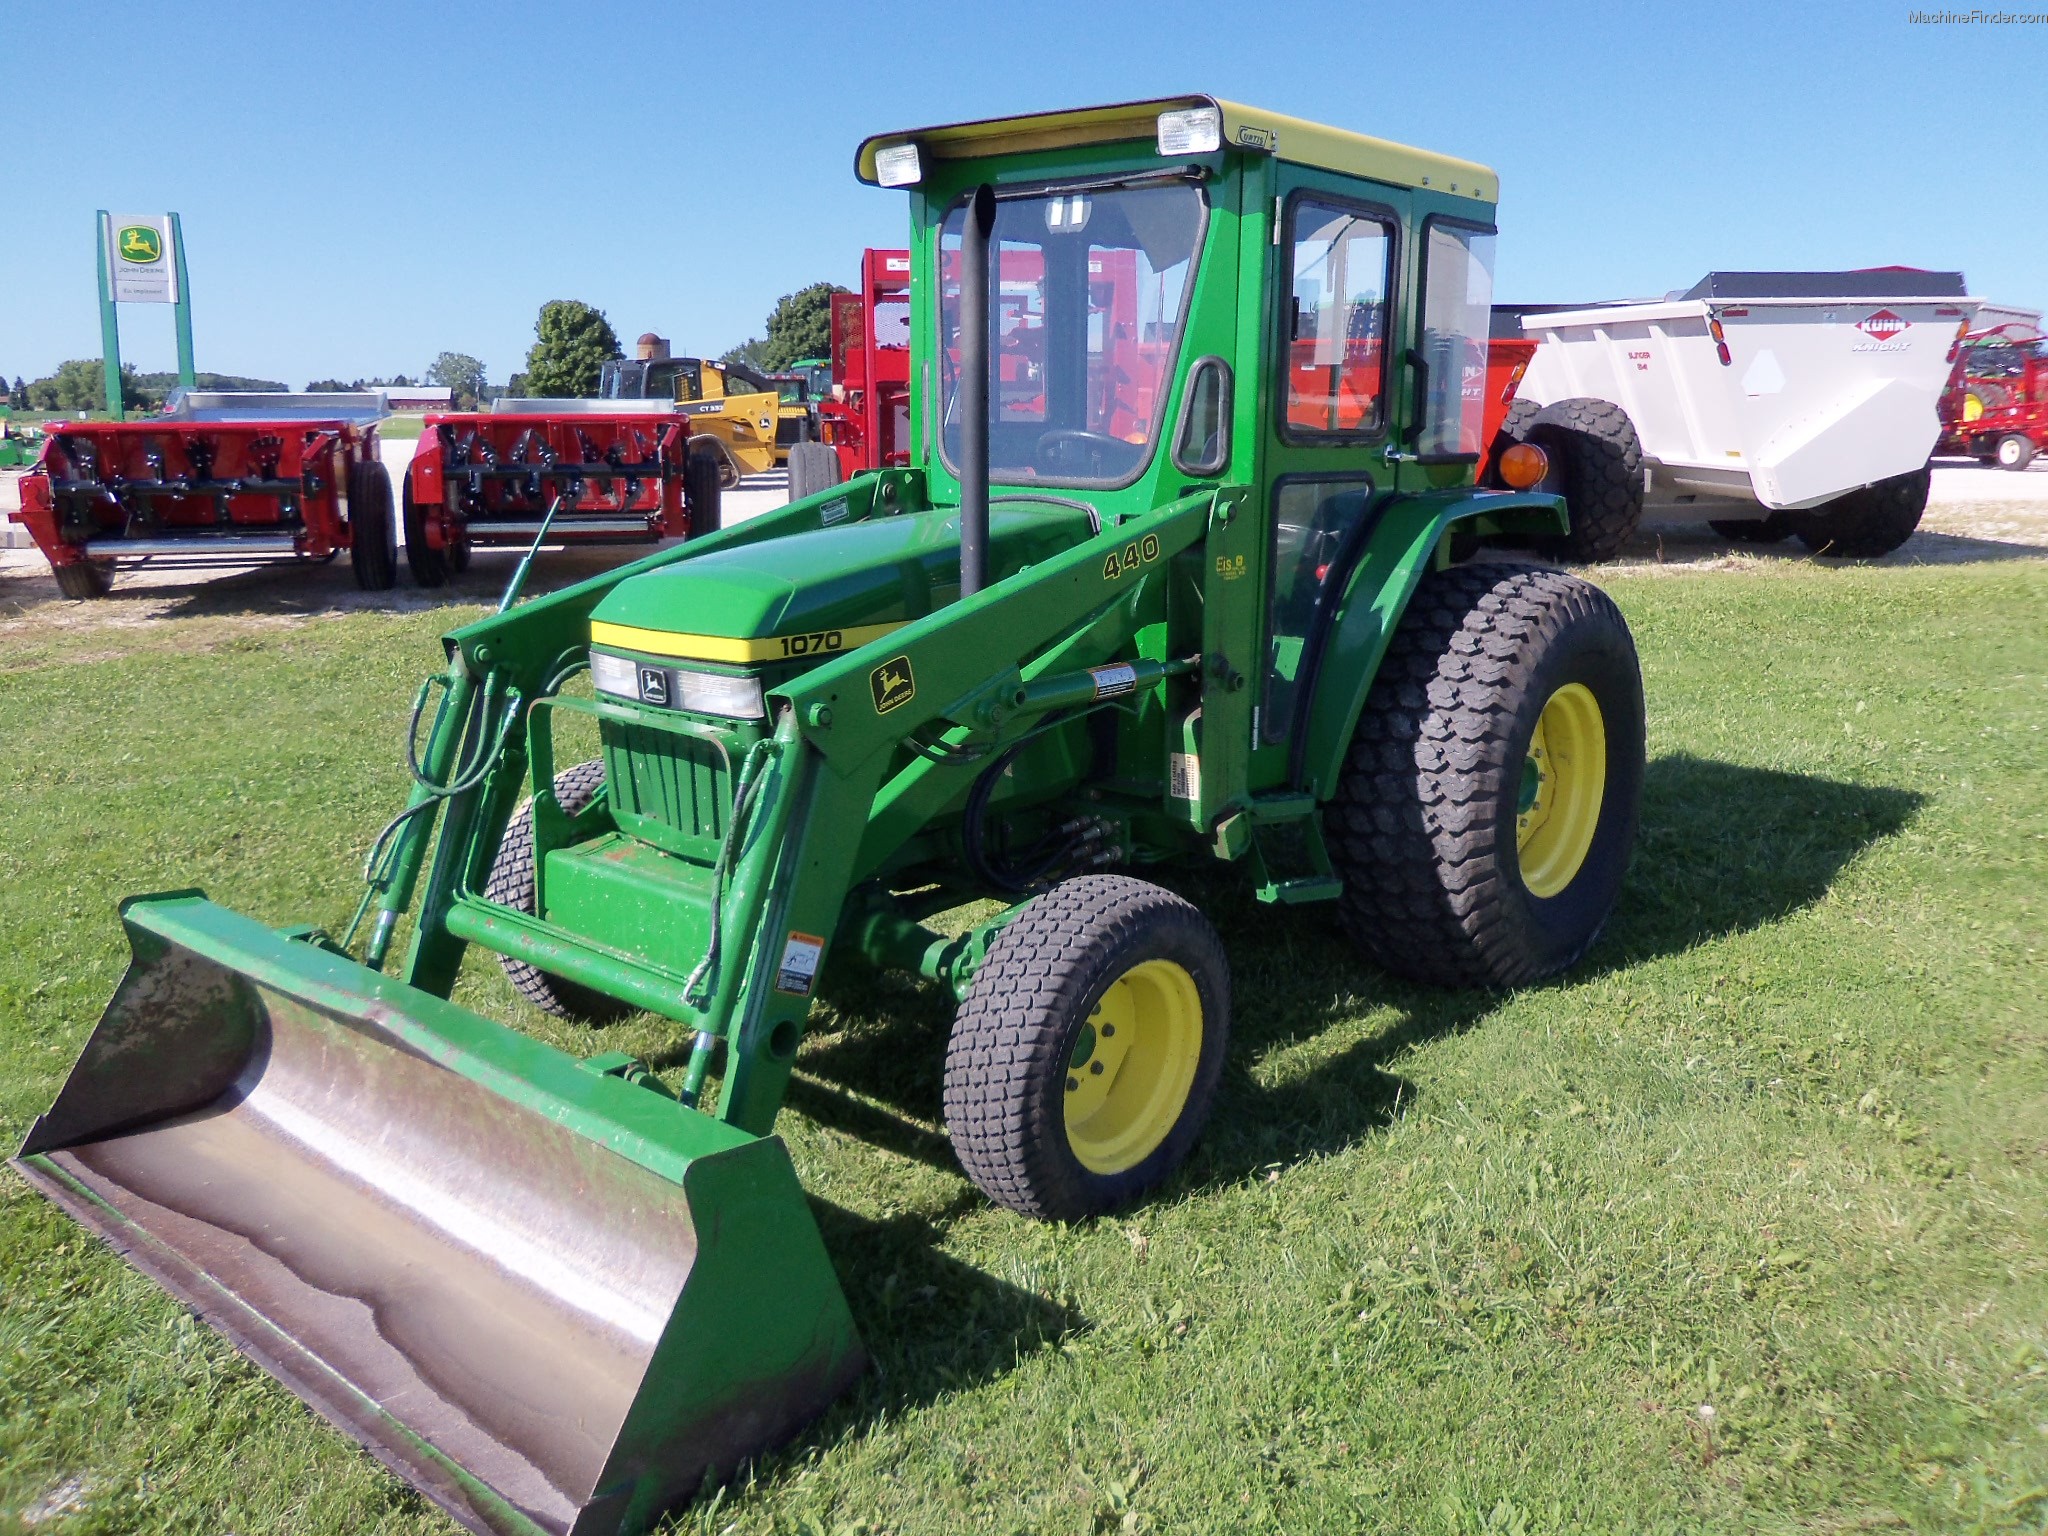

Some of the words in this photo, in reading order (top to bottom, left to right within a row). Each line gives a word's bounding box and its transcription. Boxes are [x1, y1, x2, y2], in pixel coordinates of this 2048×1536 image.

[1239, 128, 1265, 146] CURTIS
[1860, 319, 1906, 332] KUHN
[1852, 343, 1912, 352] KNIGHT
[1103, 533, 1160, 580] 440
[781, 631, 842, 657] 1070
[879, 698, 894, 711] JOHN
[893, 688, 912, 703] DEERE
